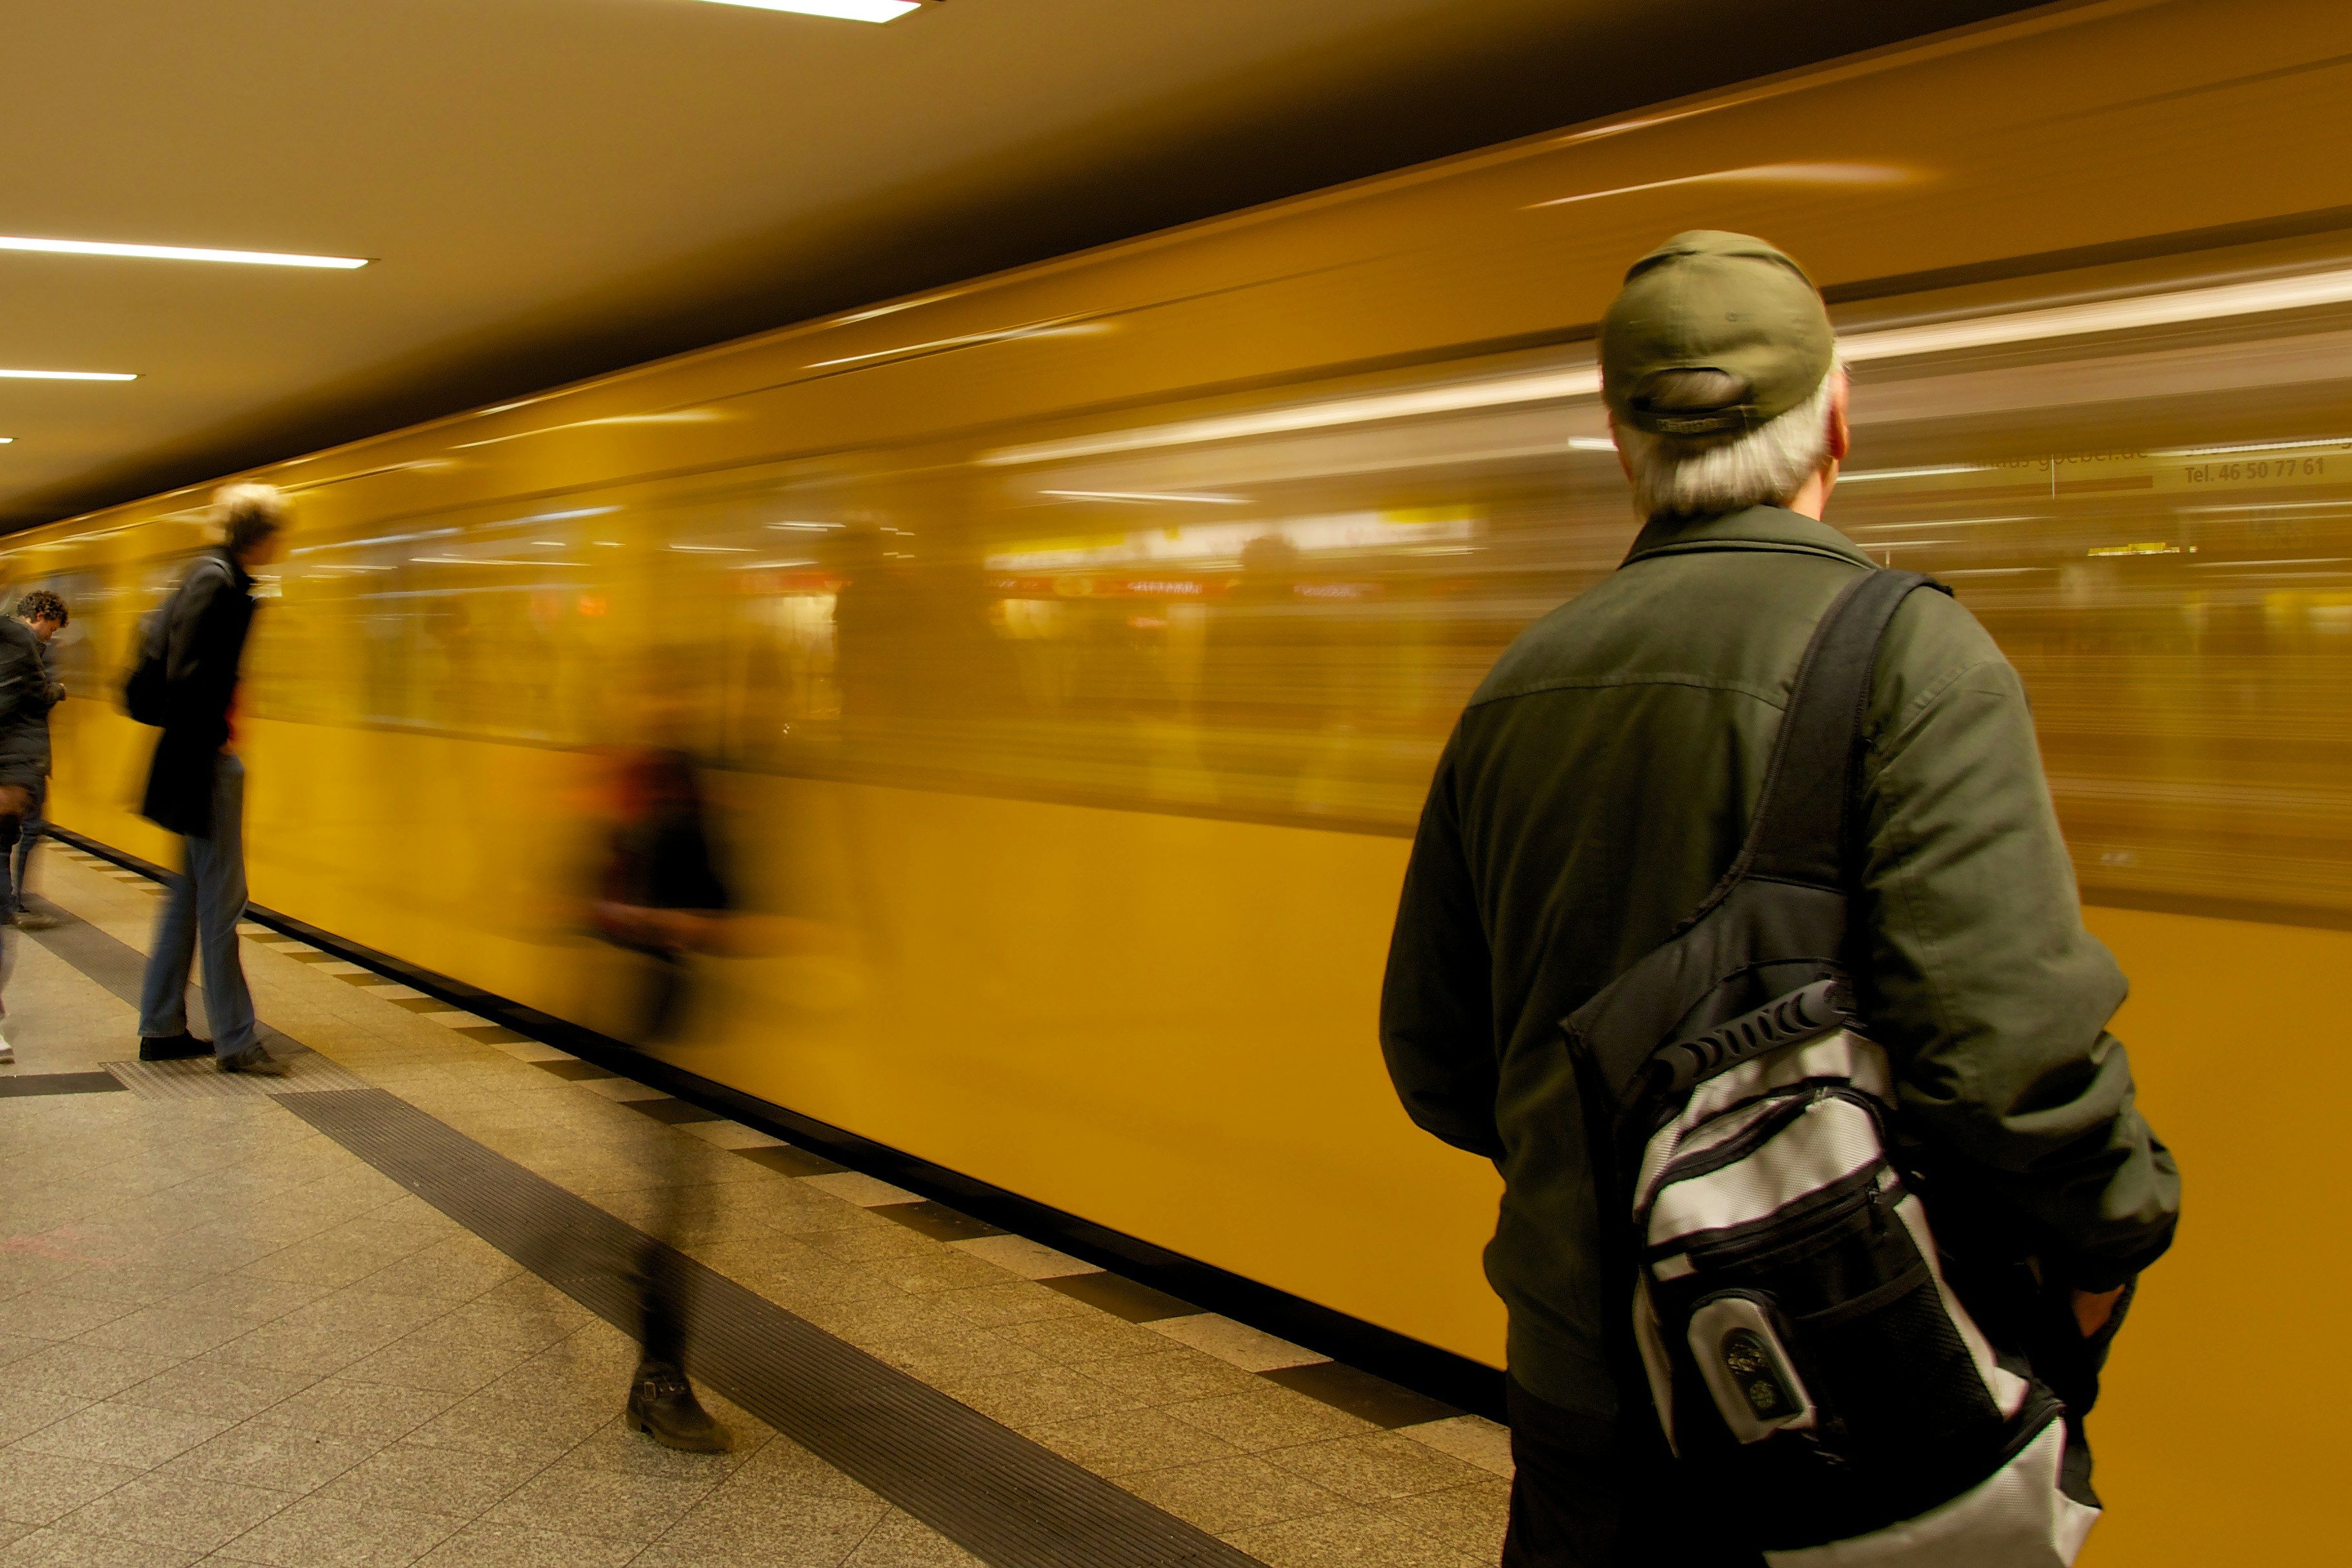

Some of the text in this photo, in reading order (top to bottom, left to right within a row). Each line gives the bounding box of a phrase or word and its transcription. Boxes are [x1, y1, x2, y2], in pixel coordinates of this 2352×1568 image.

[2185, 457, 2324, 483] Tel. 46 50 77 61
